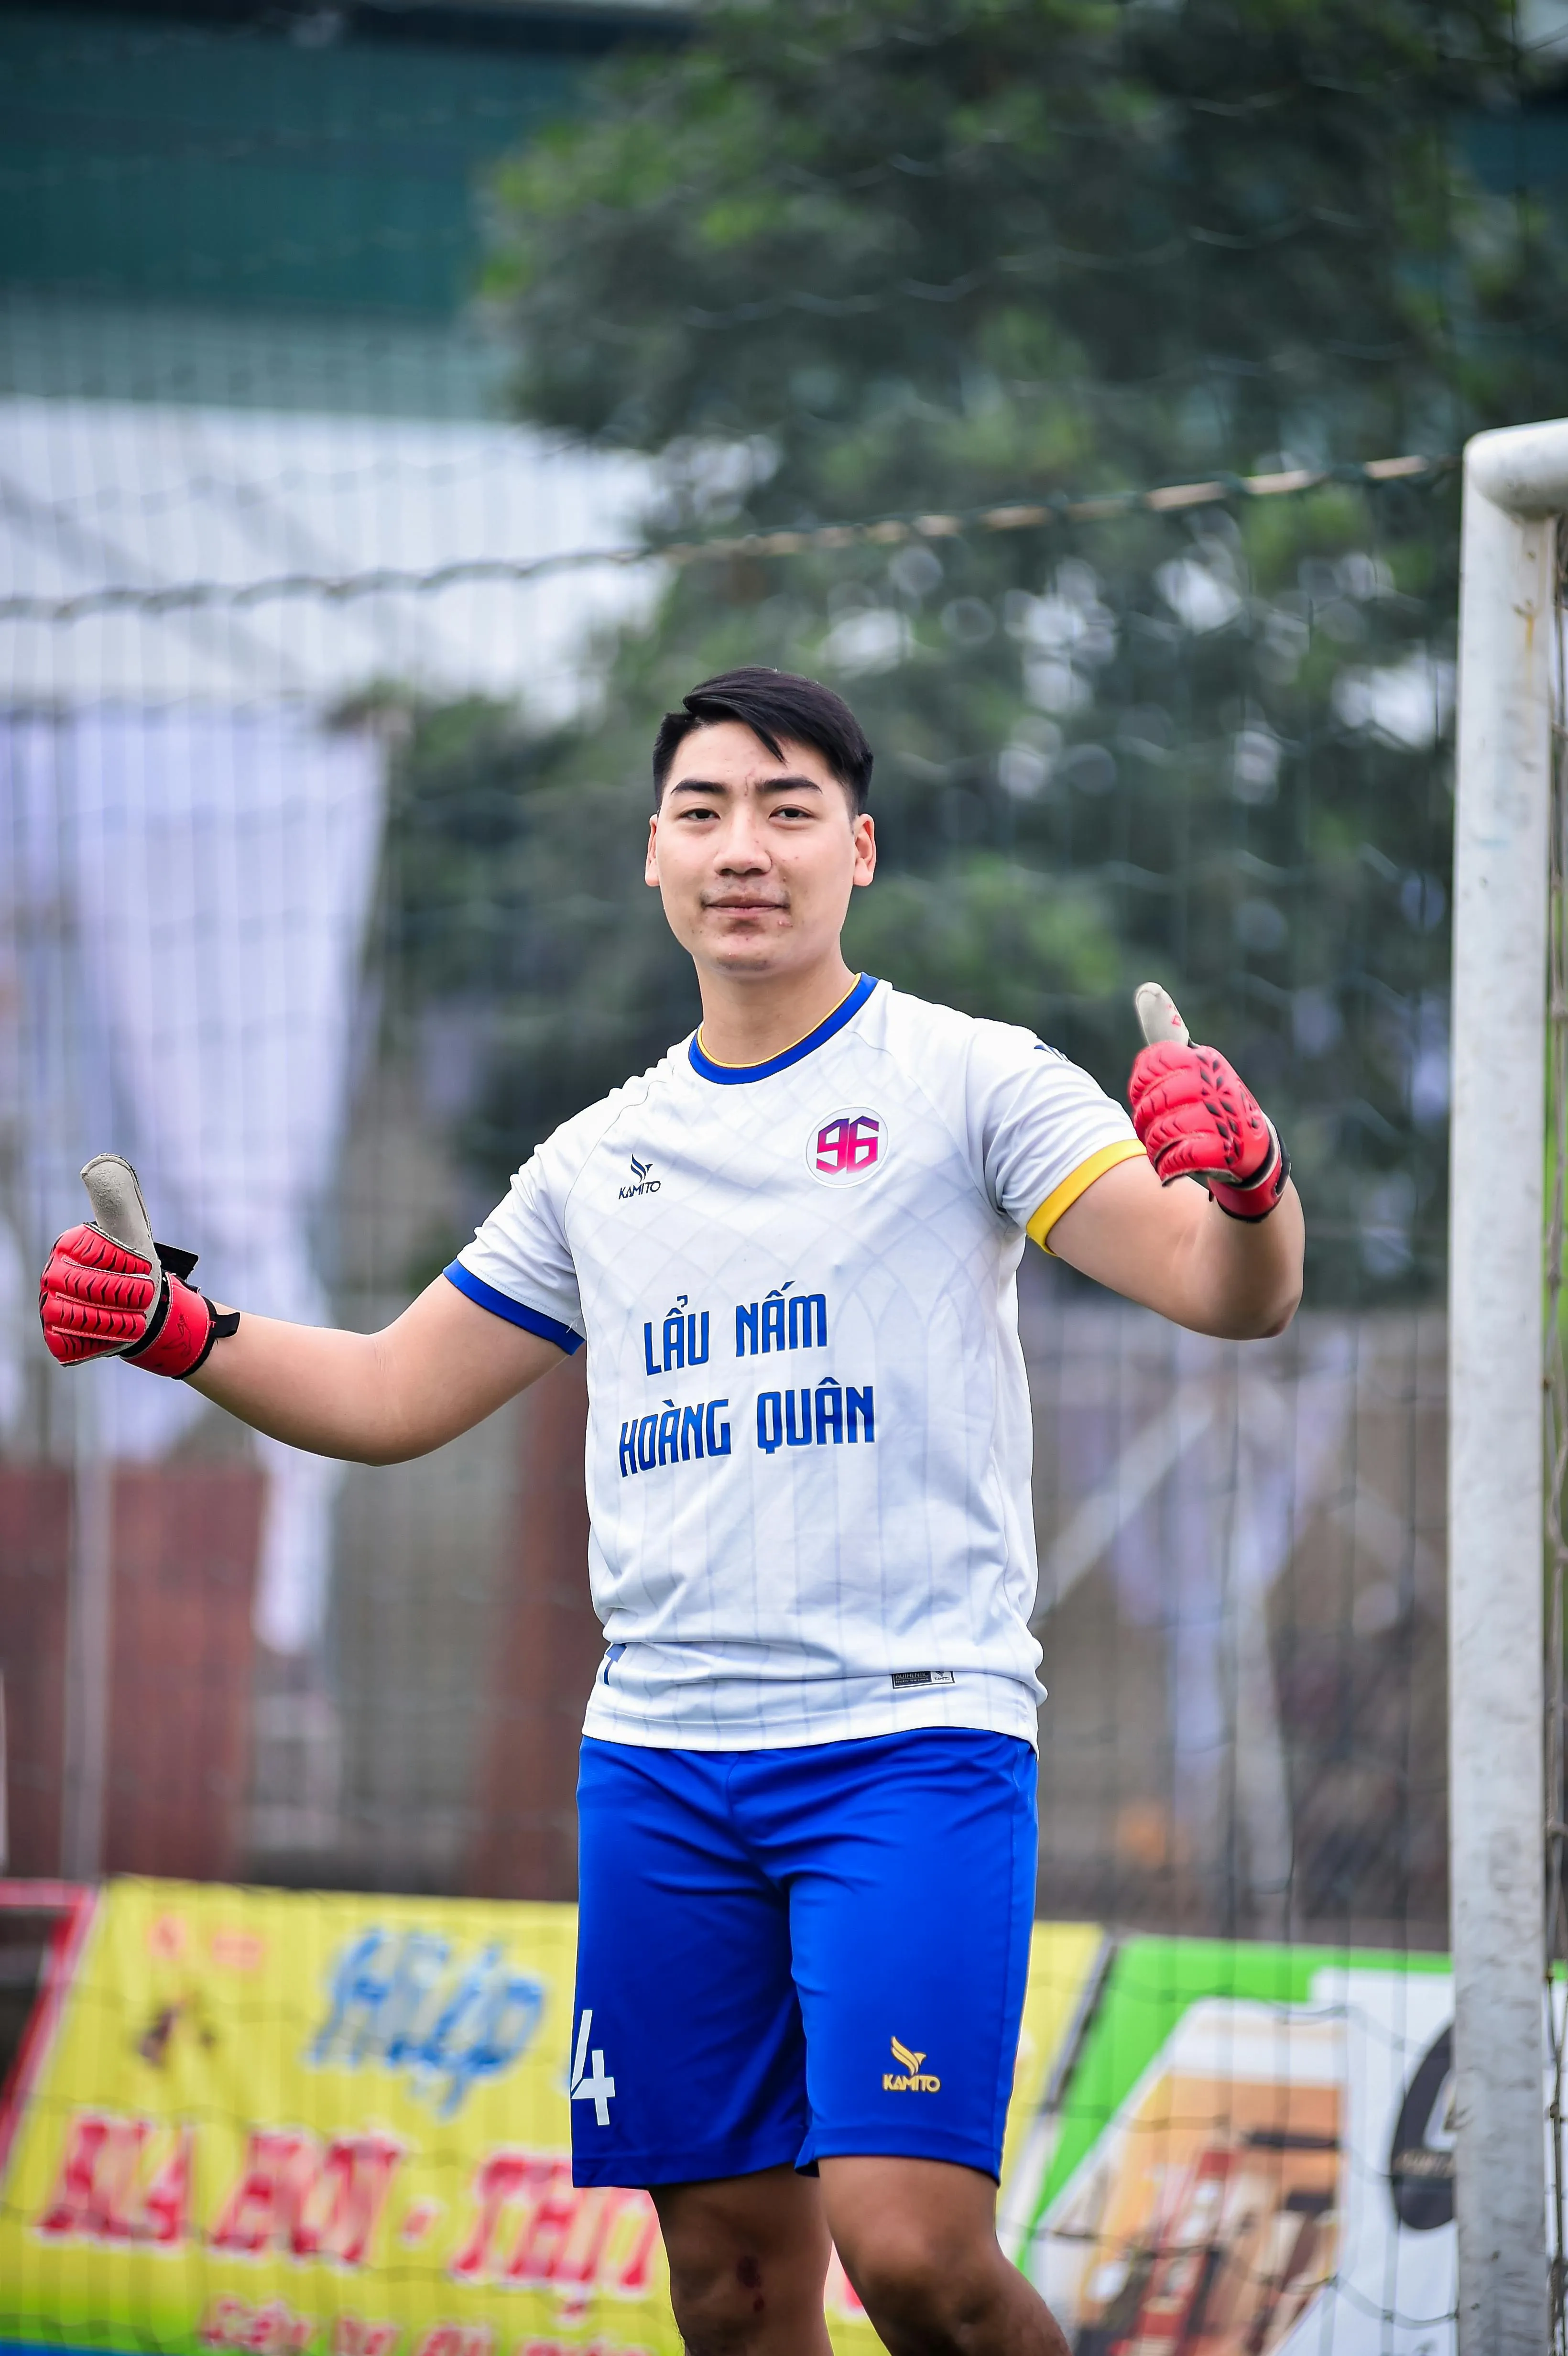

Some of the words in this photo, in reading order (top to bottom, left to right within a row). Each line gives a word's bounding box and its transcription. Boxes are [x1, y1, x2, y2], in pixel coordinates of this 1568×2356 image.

[816, 1115, 880, 1176] 96
[618, 1180, 661, 1200] KAMITO
[644, 1294, 709, 1376] LẨU
[735, 1280, 828, 1358] NẤM
[618, 1398, 732, 1478] HOÀNG
[756, 1376, 876, 1455] QUÂN
[883, 2073, 941, 2093] KAMITO
